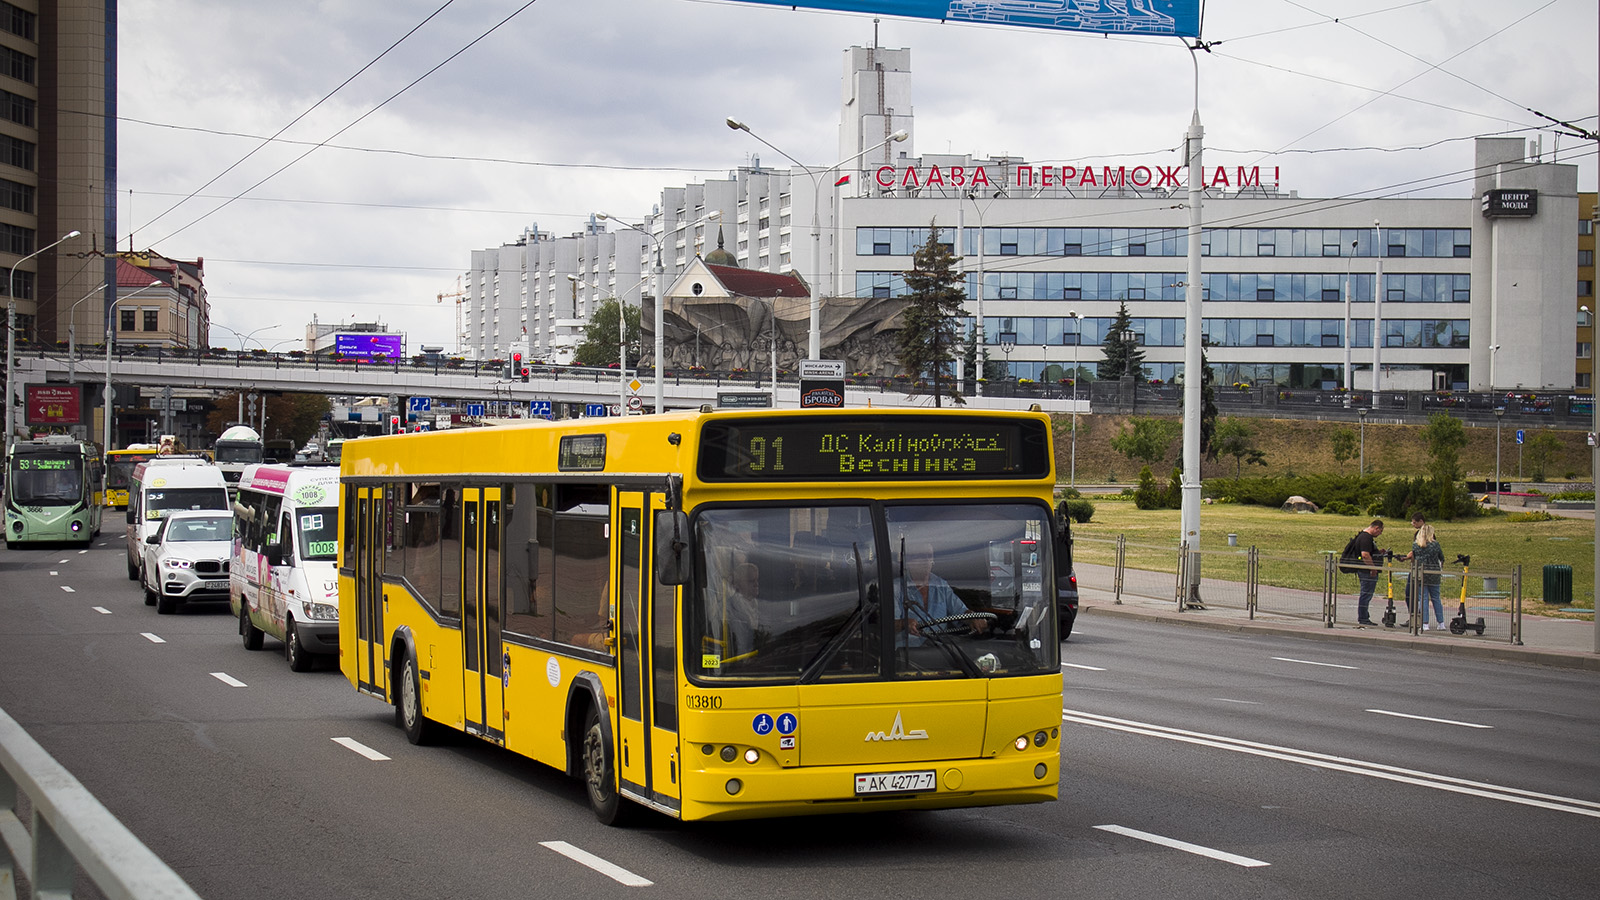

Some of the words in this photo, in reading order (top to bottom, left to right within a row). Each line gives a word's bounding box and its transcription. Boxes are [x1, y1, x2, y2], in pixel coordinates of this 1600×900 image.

[876, 165, 989, 187] СЛАВА
[1501, 193, 1529, 201] ЦЕНТР
[804, 395, 841, 405] БРОВАР
[819, 434, 849, 453] ДС
[750, 436, 784, 471] 91
[20, 460, 30, 469] 53
[839, 454, 976, 473] Веснінка
[301, 491, 318, 499] 1008
[149, 510, 159, 518] 53
[311, 544, 335, 553] 1008
[686, 695, 723, 709] 013810
[869, 776, 887, 791] AK
[891, 774, 933, 789] 4277-7
